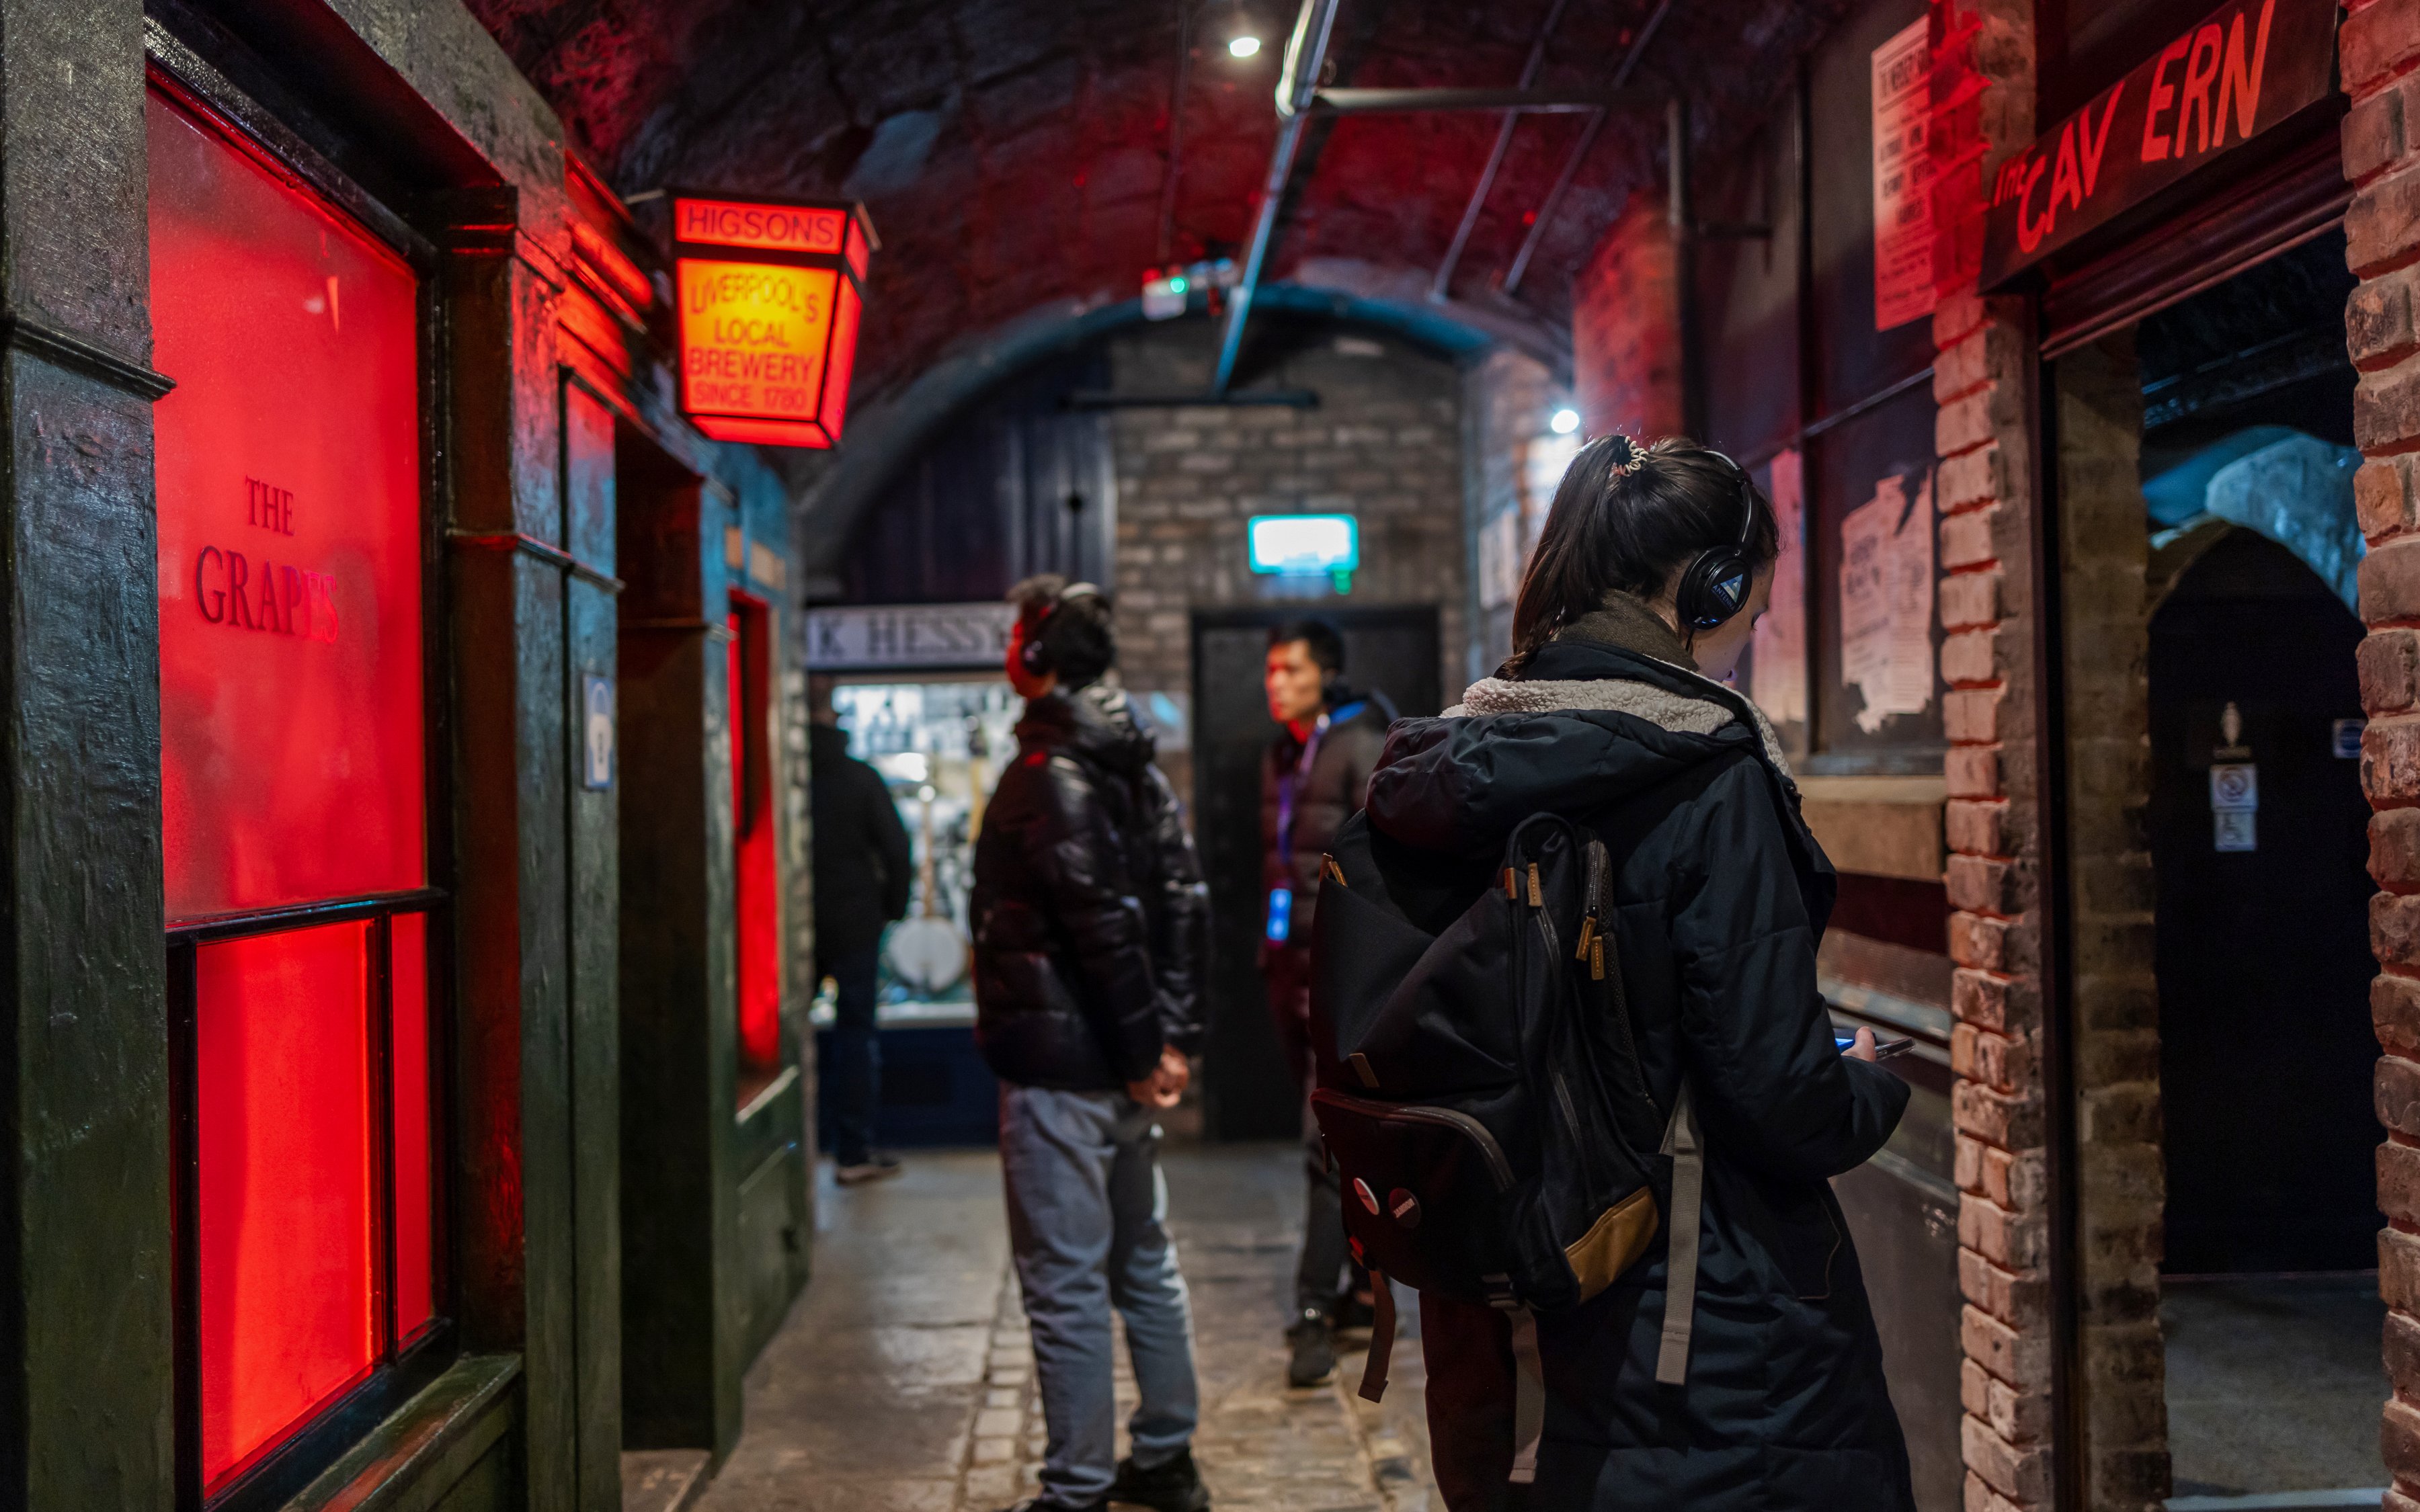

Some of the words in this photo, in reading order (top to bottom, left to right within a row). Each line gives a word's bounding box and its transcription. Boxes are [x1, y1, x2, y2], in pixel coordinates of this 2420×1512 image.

[686, 205, 836, 245] HIGSONS
[714, 317, 791, 349] LOCAL
[688, 347, 815, 383] BREWERY
[694, 380, 752, 408] SINCE
[245, 474, 294, 536] THE
[196, 545, 338, 644] GRAPES
